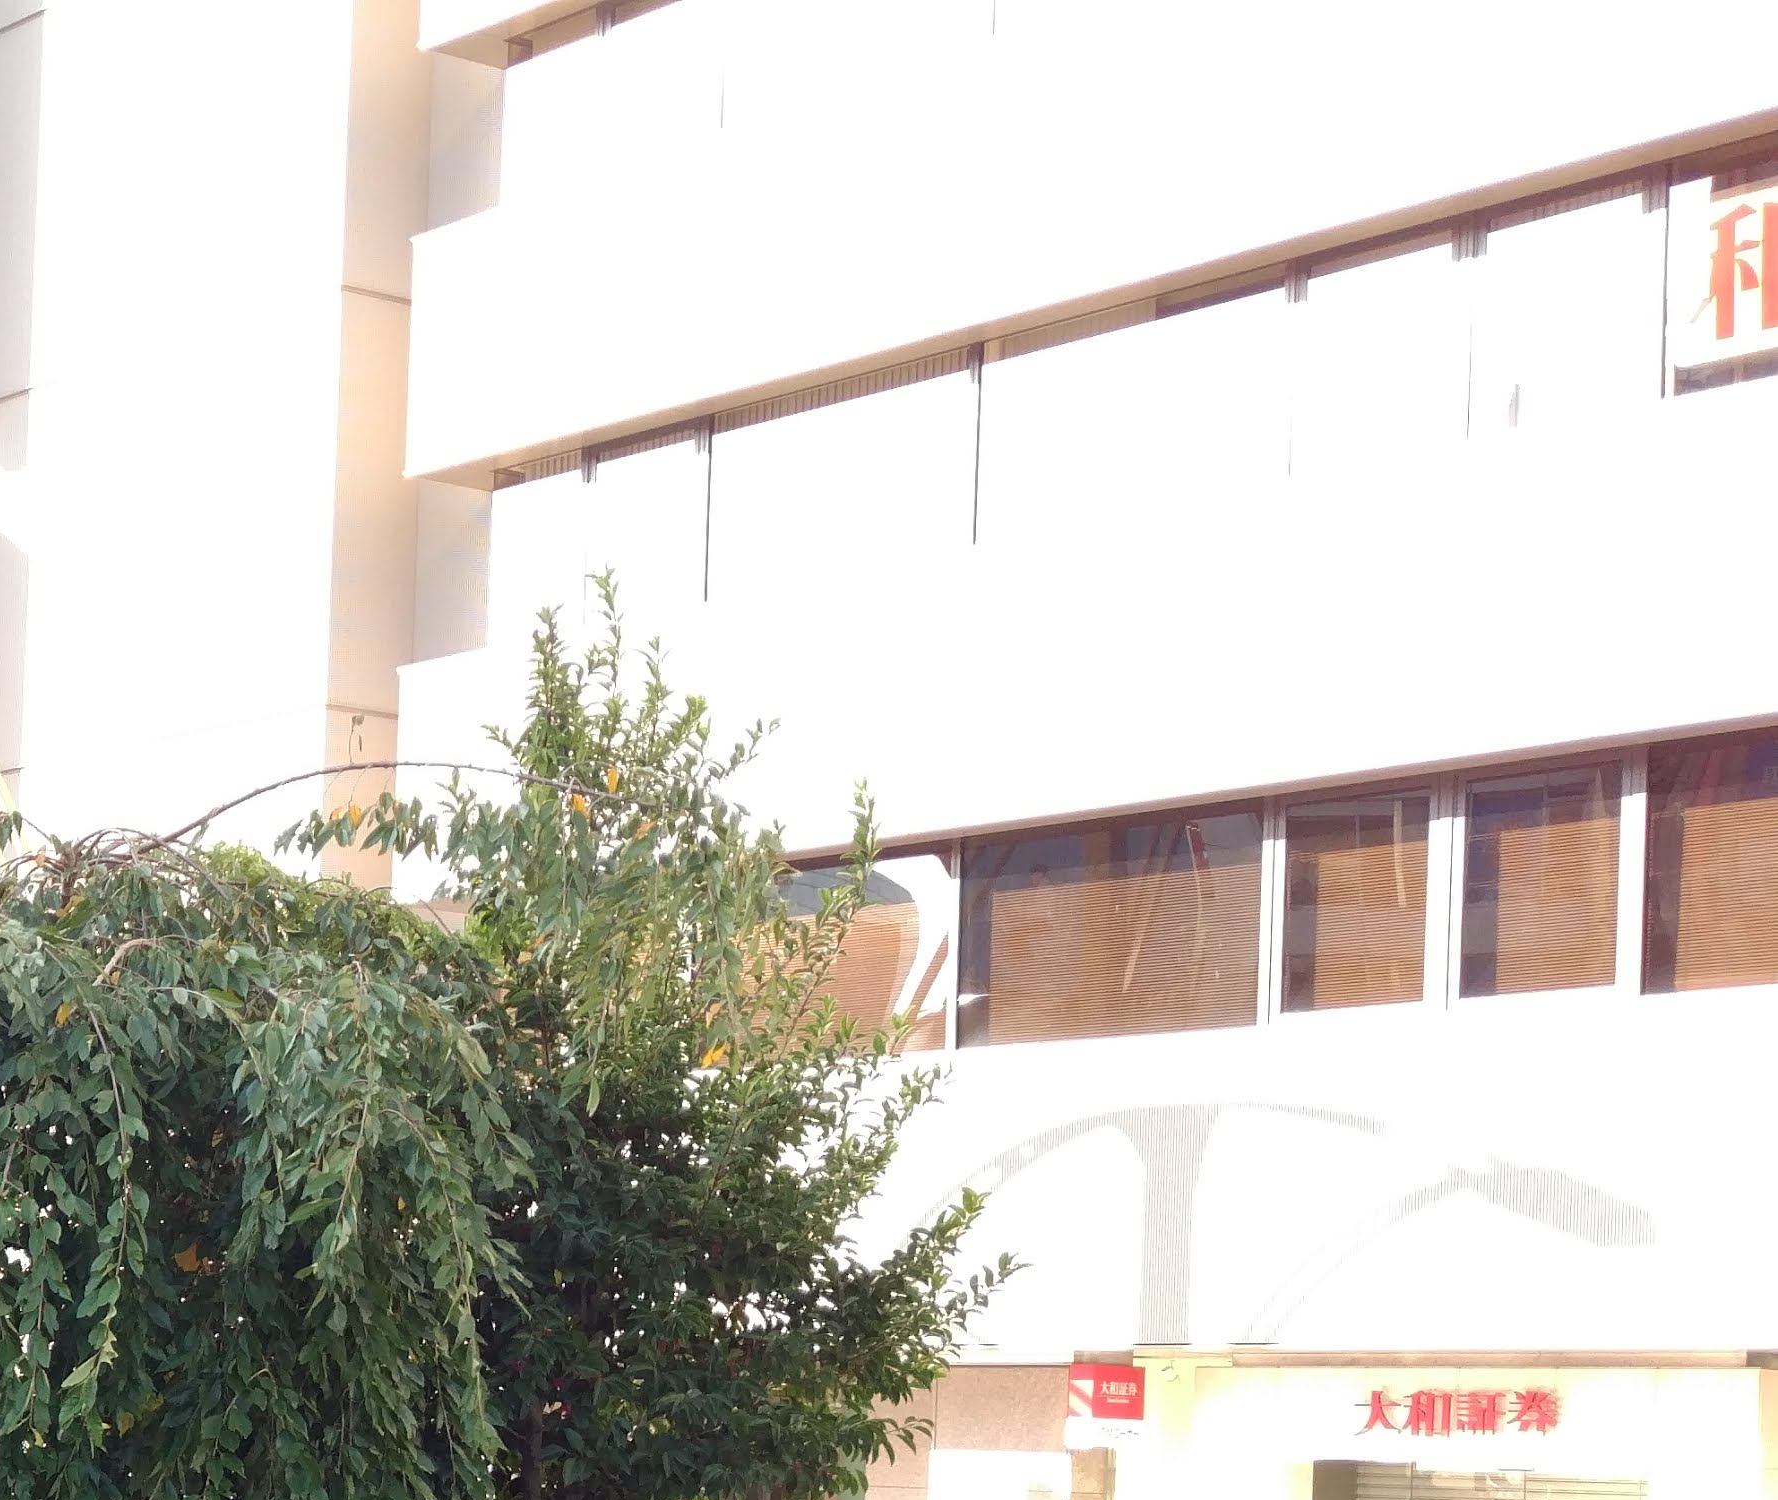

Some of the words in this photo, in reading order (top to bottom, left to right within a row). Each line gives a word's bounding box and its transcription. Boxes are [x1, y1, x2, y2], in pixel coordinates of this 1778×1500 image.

[1100, 1380, 1138, 1397] 大和証券
[1354, 1388, 1561, 1437] 大和証券
